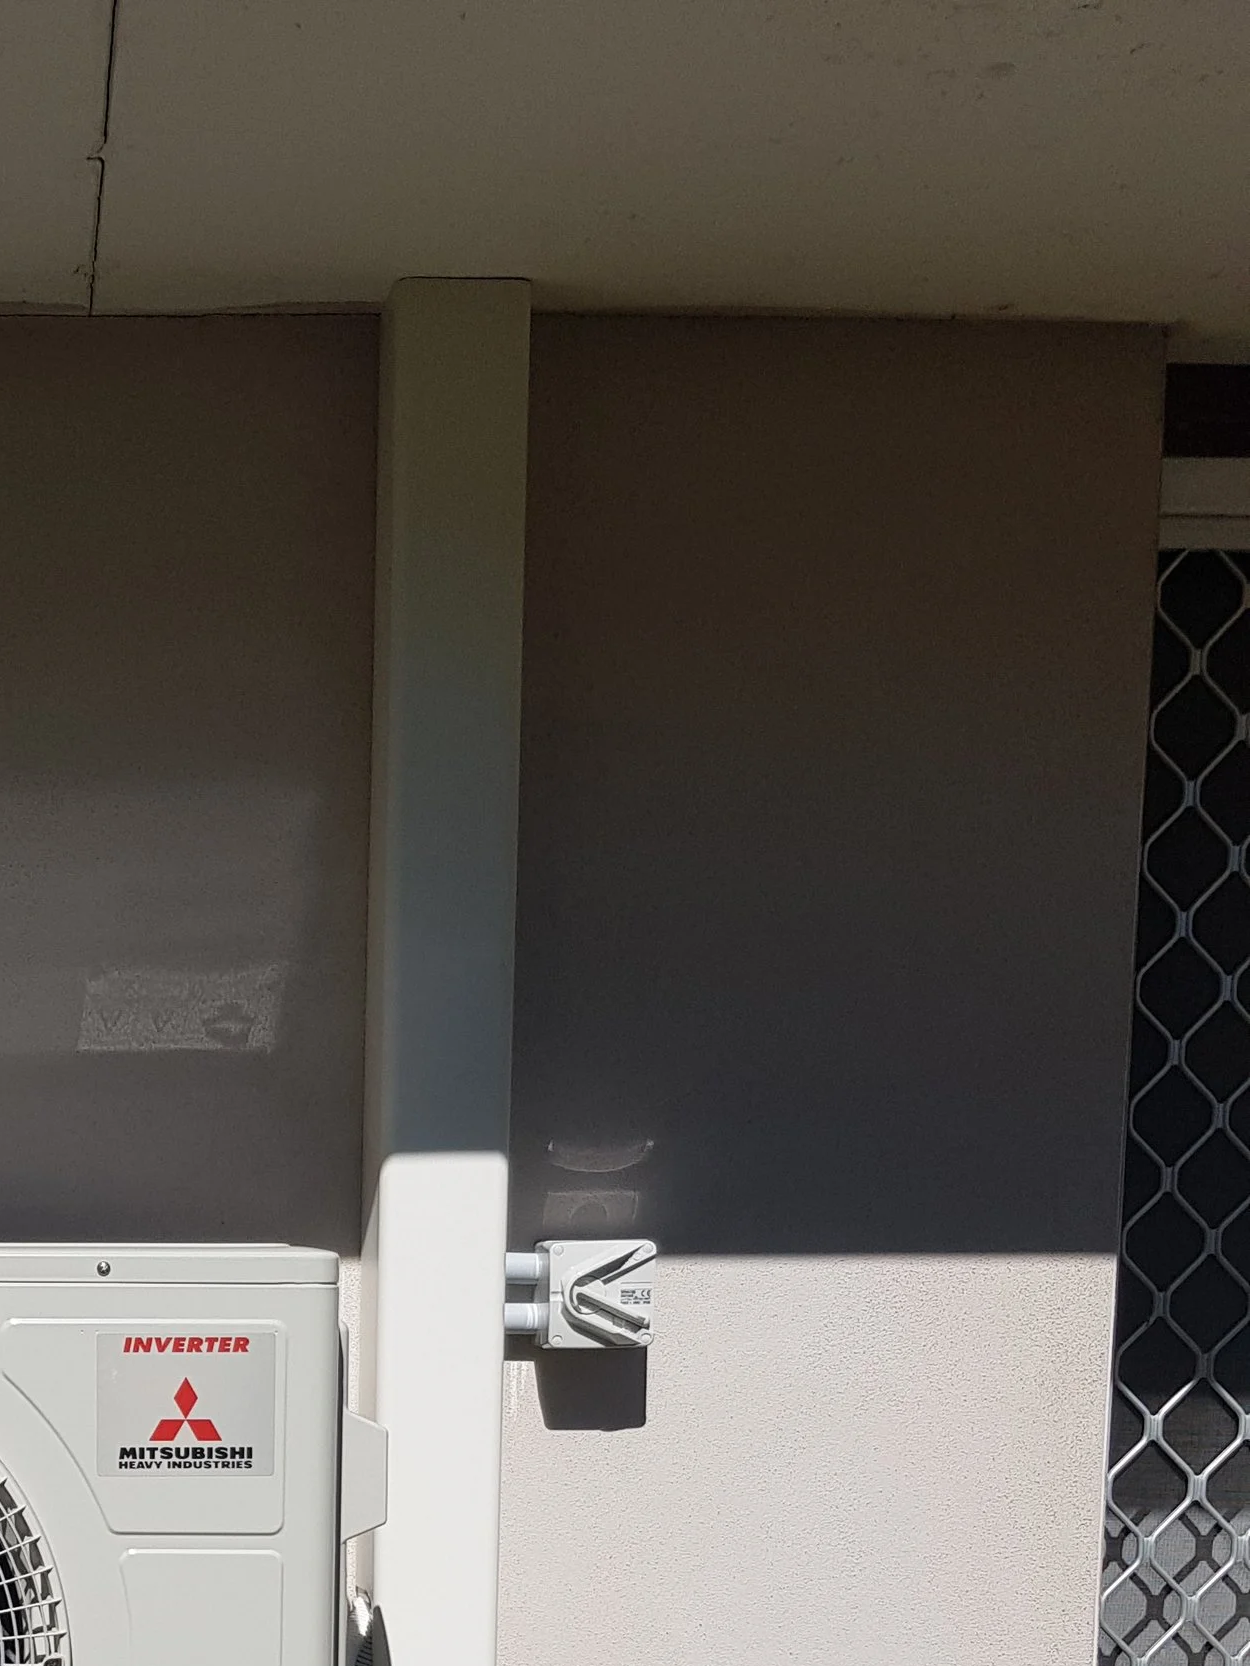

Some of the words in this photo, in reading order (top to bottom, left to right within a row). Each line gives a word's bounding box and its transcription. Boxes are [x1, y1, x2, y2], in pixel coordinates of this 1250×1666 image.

[123, 1337, 250, 1353] INVERTER
[118, 1447, 253, 1459] MITSUBISHI
[118, 1460, 163, 1469] HEAVY
[167, 1460, 253, 1469] INDUSTRIES
